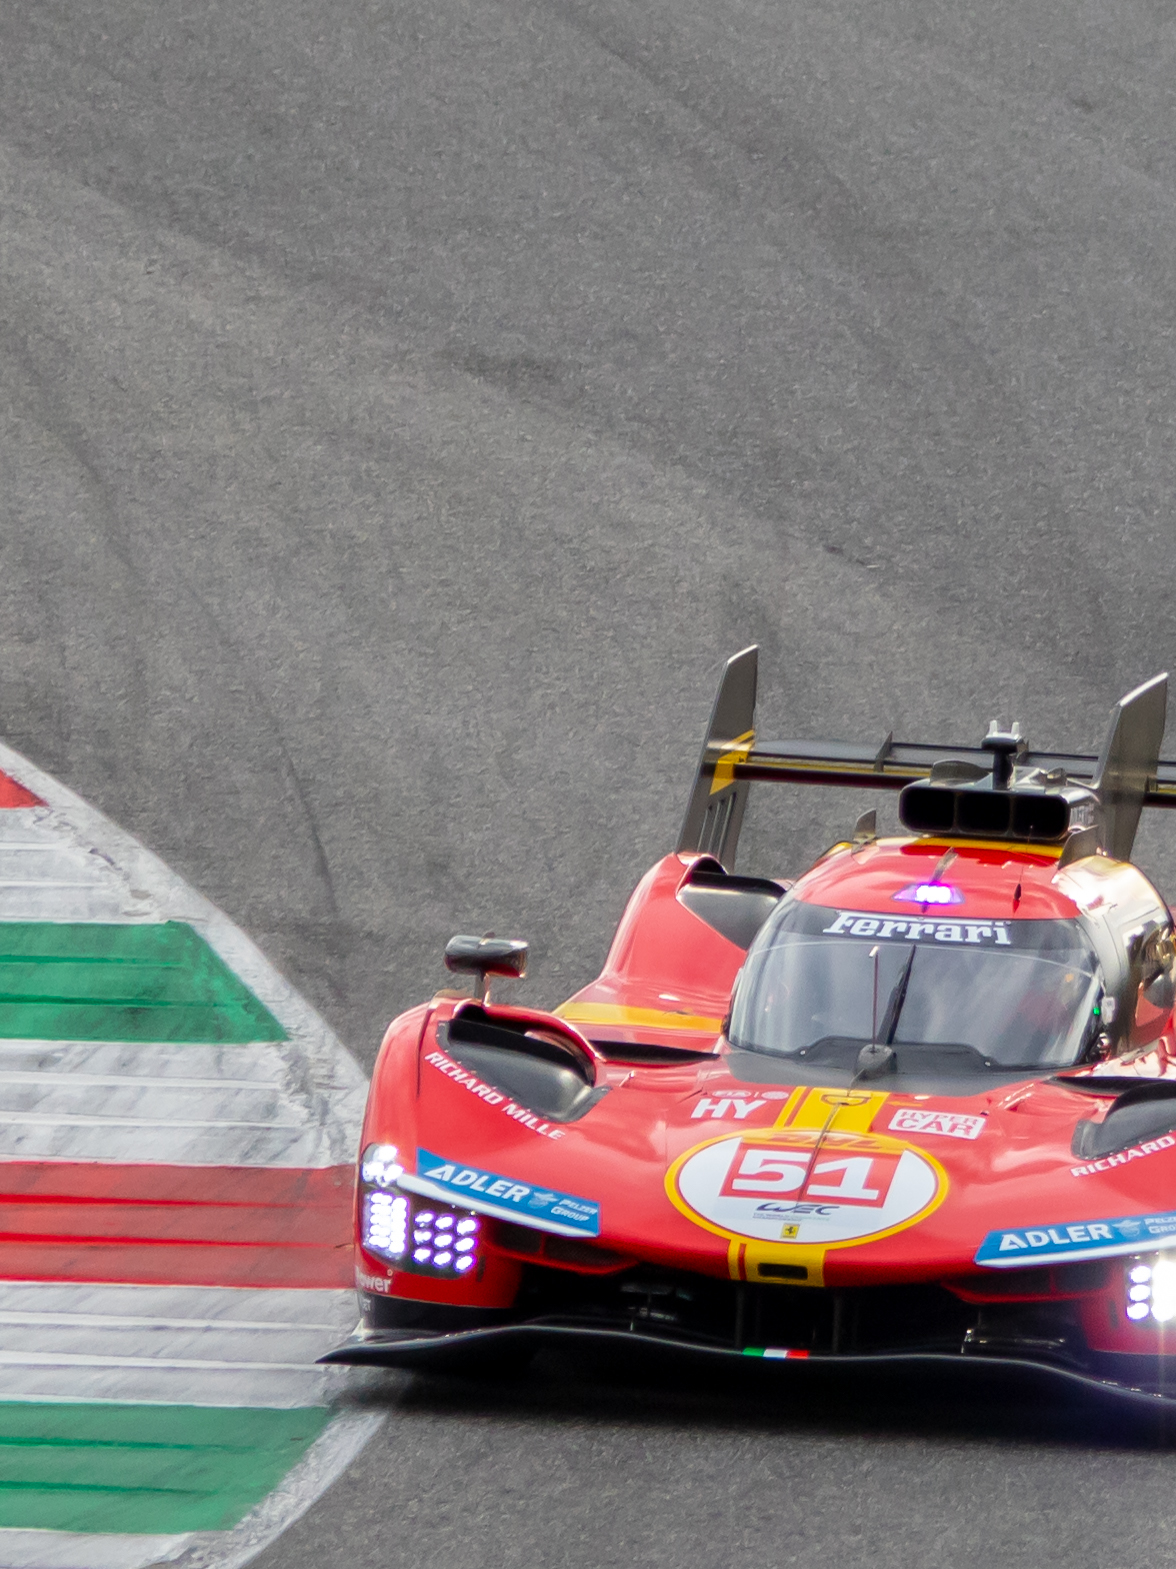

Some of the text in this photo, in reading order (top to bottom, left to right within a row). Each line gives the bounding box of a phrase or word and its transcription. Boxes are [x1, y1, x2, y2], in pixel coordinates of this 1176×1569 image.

[822, 908, 1012, 945] Ferrari
[424, 1051, 566, 1140] RICHARD MILLE
[691, 1098, 768, 1119] HY
[900, 1111, 978, 1125] HYPER
[896, 1118, 974, 1136] CAR
[1070, 1136, 1176, 1177] RICHARD
[424, 1164, 530, 1203] ADLER
[732, 1149, 880, 1200] 51
[550, 1206, 590, 1222] GROUP
[558, 1199, 598, 1215] PELZER
[756, 1202, 840, 1216] WEC
[999, 1223, 1113, 1251] ADLER
